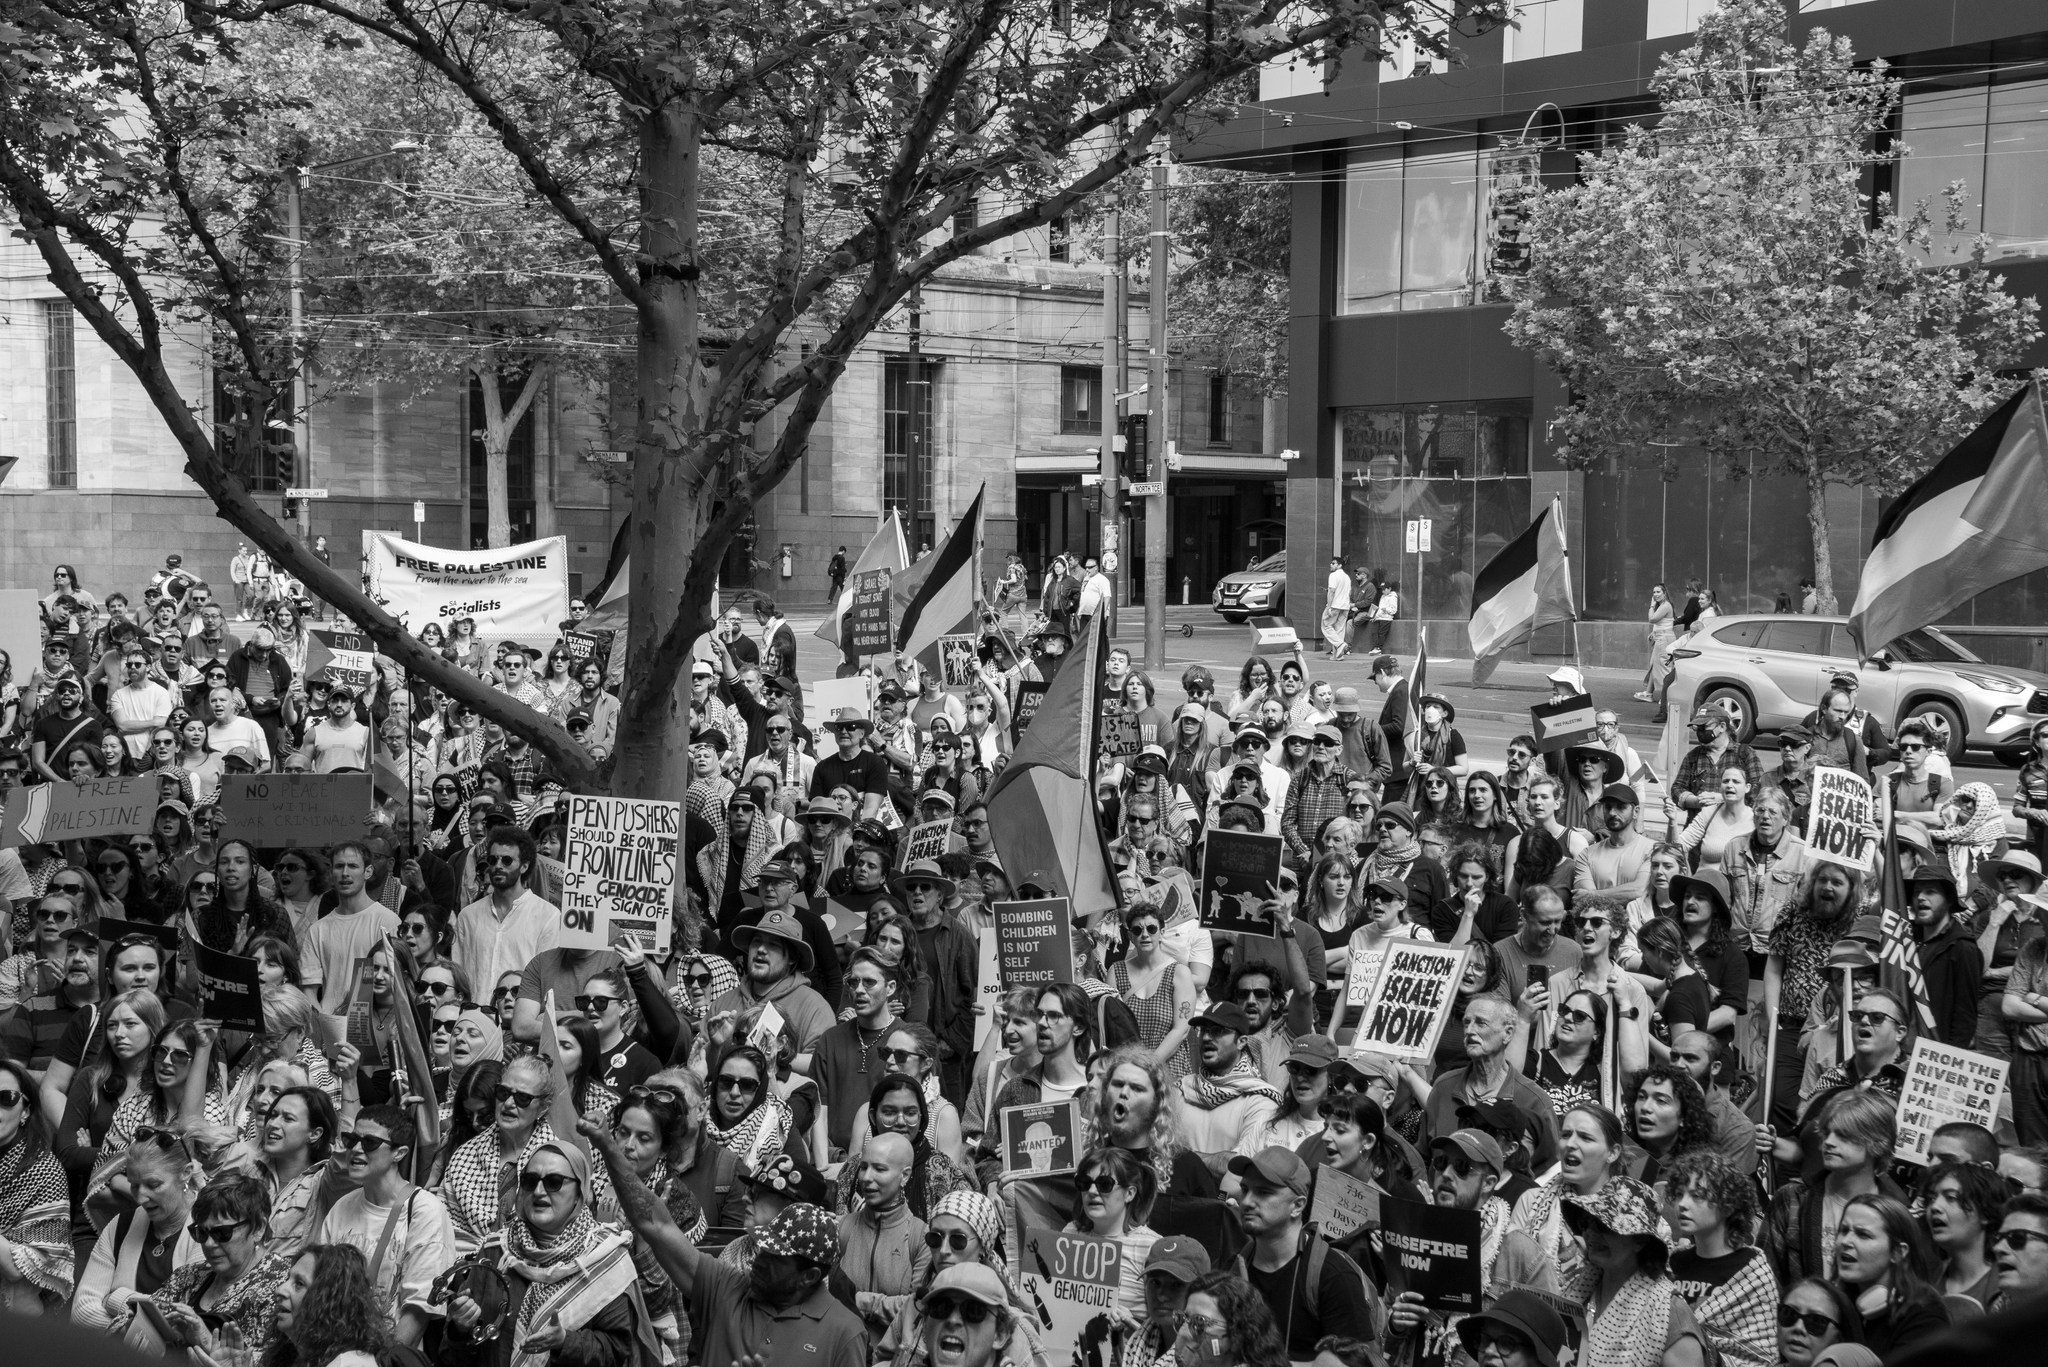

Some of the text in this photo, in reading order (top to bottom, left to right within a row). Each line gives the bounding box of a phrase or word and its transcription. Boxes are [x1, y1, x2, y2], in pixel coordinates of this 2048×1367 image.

[395, 554, 547, 575] FREE PALESTINE
[415, 572, 528, 585] From the river to the sea
[864, 578, 877, 590] ISRAEL
[438, 598, 501, 618] Socialists
[860, 608, 880, 618] WITH BLOOD
[855, 623, 860, 632] ON
[868, 622, 878, 632] HANDS
[334, 634, 361, 650] END
[566, 636, 594, 647] STAND
[570, 642, 591, 652] WITH
[861, 636, 870, 646] NEVER
[870, 635, 879, 645] WASH
[336, 653, 364, 668] THE
[324, 666, 366, 684] SIEGE
[1022, 692, 1044, 706] ISR
[830, 708, 842, 716] FR
[1562, 718, 1582, 726] PALESTINE
[76, 780, 131, 798] FREE
[246, 783, 328, 798] NO PEACE
[1820, 773, 1869, 802] SANCTION
[272, 802, 318, 812] WITH
[572, 798, 680, 834] PEN PUSHERS
[1818, 792, 1869, 824] ISRAEL
[50, 806, 142, 831] PALESTINE
[232, 815, 356, 828] WAR CRIMINALS
[570, 826, 677, 853] SHOULD BE ON THE
[912, 822, 950, 842] SANCTION
[1812, 818, 1866, 860] NOW
[908, 838, 944, 860] ISRAEL
[1212, 840, 1228, 848] YOU
[1250, 844, 1276, 856] PAUSE
[568, 840, 676, 886] FRONTLINES
[564, 872, 586, 888] OF
[597, 880, 666, 906] GENOCIDE
[564, 891, 669, 920] THEY SIGN OFF
[564, 908, 594, 933] ON
[1000, 910, 1053, 924] BOMBING
[1002, 924, 1056, 938] CHILDREN
[1003, 941, 1040, 953] IS NOT
[1004, 956, 1030, 968] SELF
[1392, 950, 1456, 976] SANCTION
[1006, 970, 1054, 982] DEFENCE
[1379, 974, 1444, 1008] ISRAEL
[1366, 1004, 1435, 1046] NOW
[1918, 1047, 2001, 1080] FROM THE
[1914, 1062, 1996, 1095] RIVER TO
[1912, 1078, 1992, 1113] THE SEA
[1902, 1108, 1946, 1131] WIL
[1906, 1094, 1990, 1126] PALESTINE
[1020, 1136, 1062, 1152] WANTED
[1344, 1184, 1364, 1200] 736
[1333, 1208, 1356, 1227] Days
[1384, 1230, 1468, 1260] CEASEFIRE
[1055, 1236, 1117, 1282] STOP
[1400, 1252, 1432, 1272] NOW
[1054, 1280, 1114, 1308] GENOCIDE
[1554, 1297, 1584, 1318] PALESTINE
